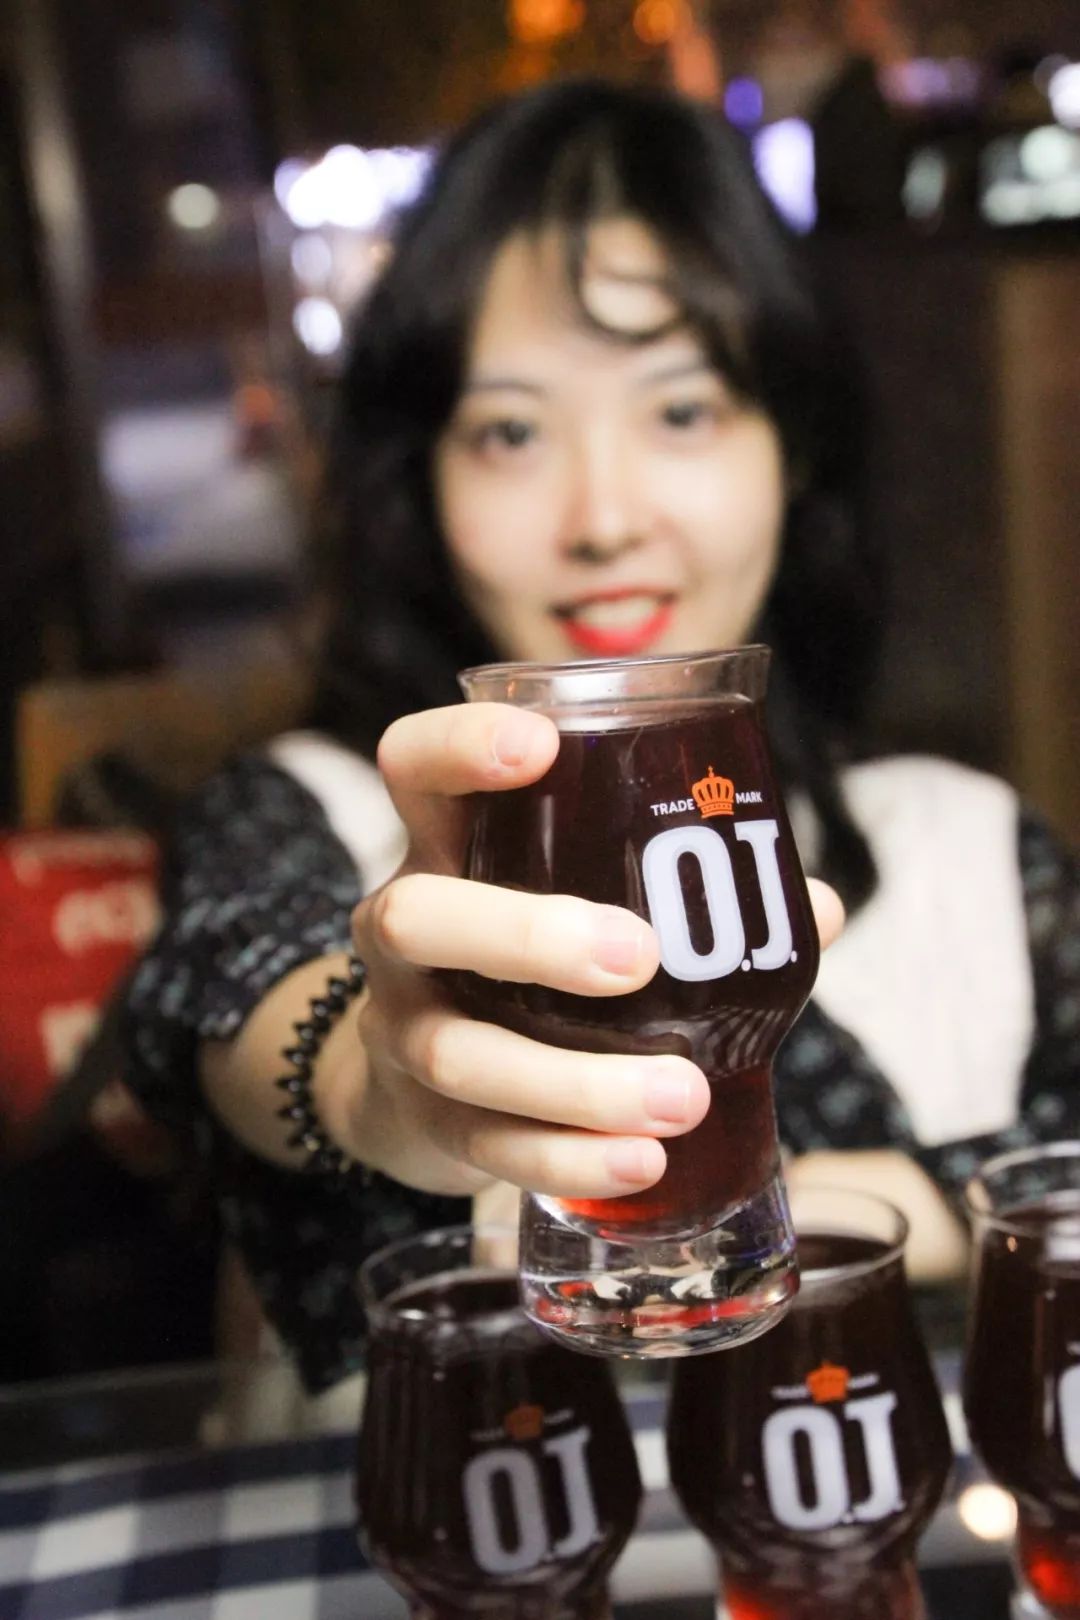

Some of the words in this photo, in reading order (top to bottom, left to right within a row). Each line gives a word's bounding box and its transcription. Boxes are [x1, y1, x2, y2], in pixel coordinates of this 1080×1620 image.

[650, 798, 696, 817] TRADE
[735, 790, 763, 805] MARK
[642, 819, 798, 982] O.J.
